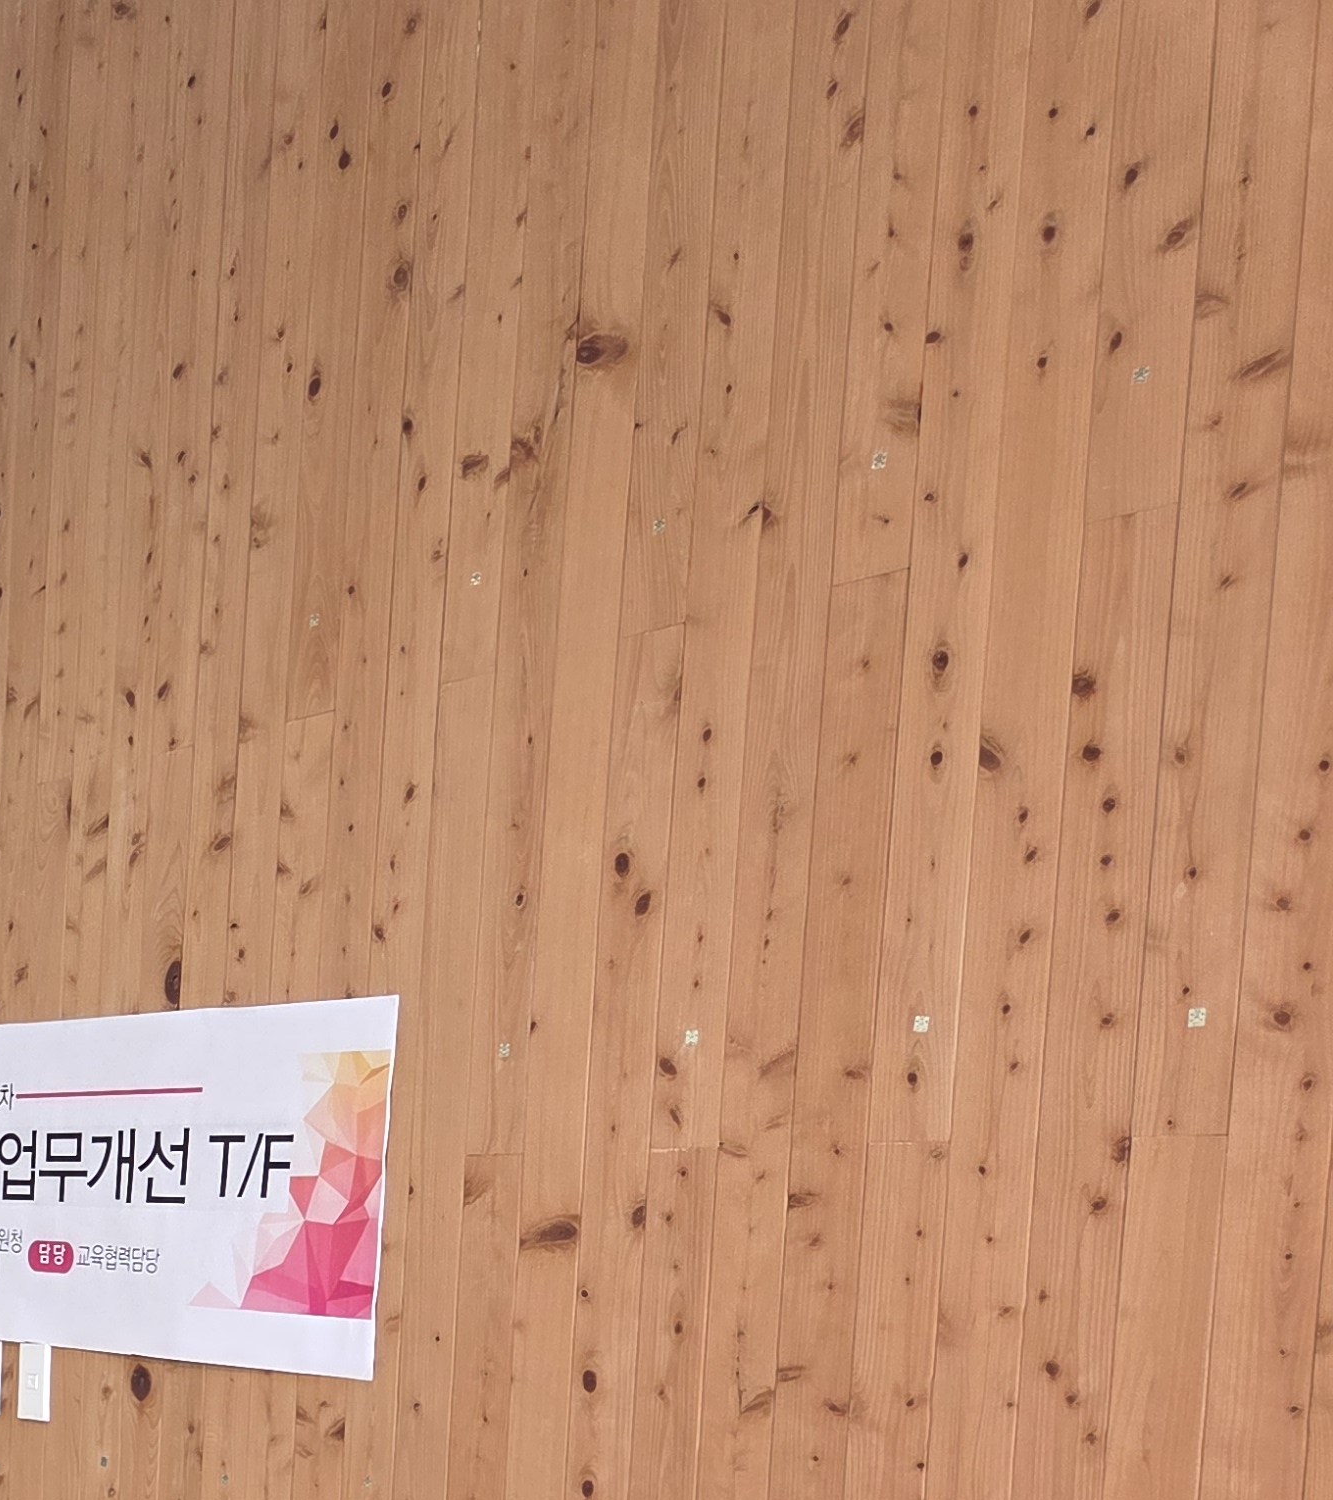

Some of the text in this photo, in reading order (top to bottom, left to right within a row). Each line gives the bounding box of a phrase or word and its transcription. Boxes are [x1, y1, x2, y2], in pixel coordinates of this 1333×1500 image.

[209, 1133, 295, 1199] T/F
[38, 1243, 161, 1274] 담당 교육협력담당
